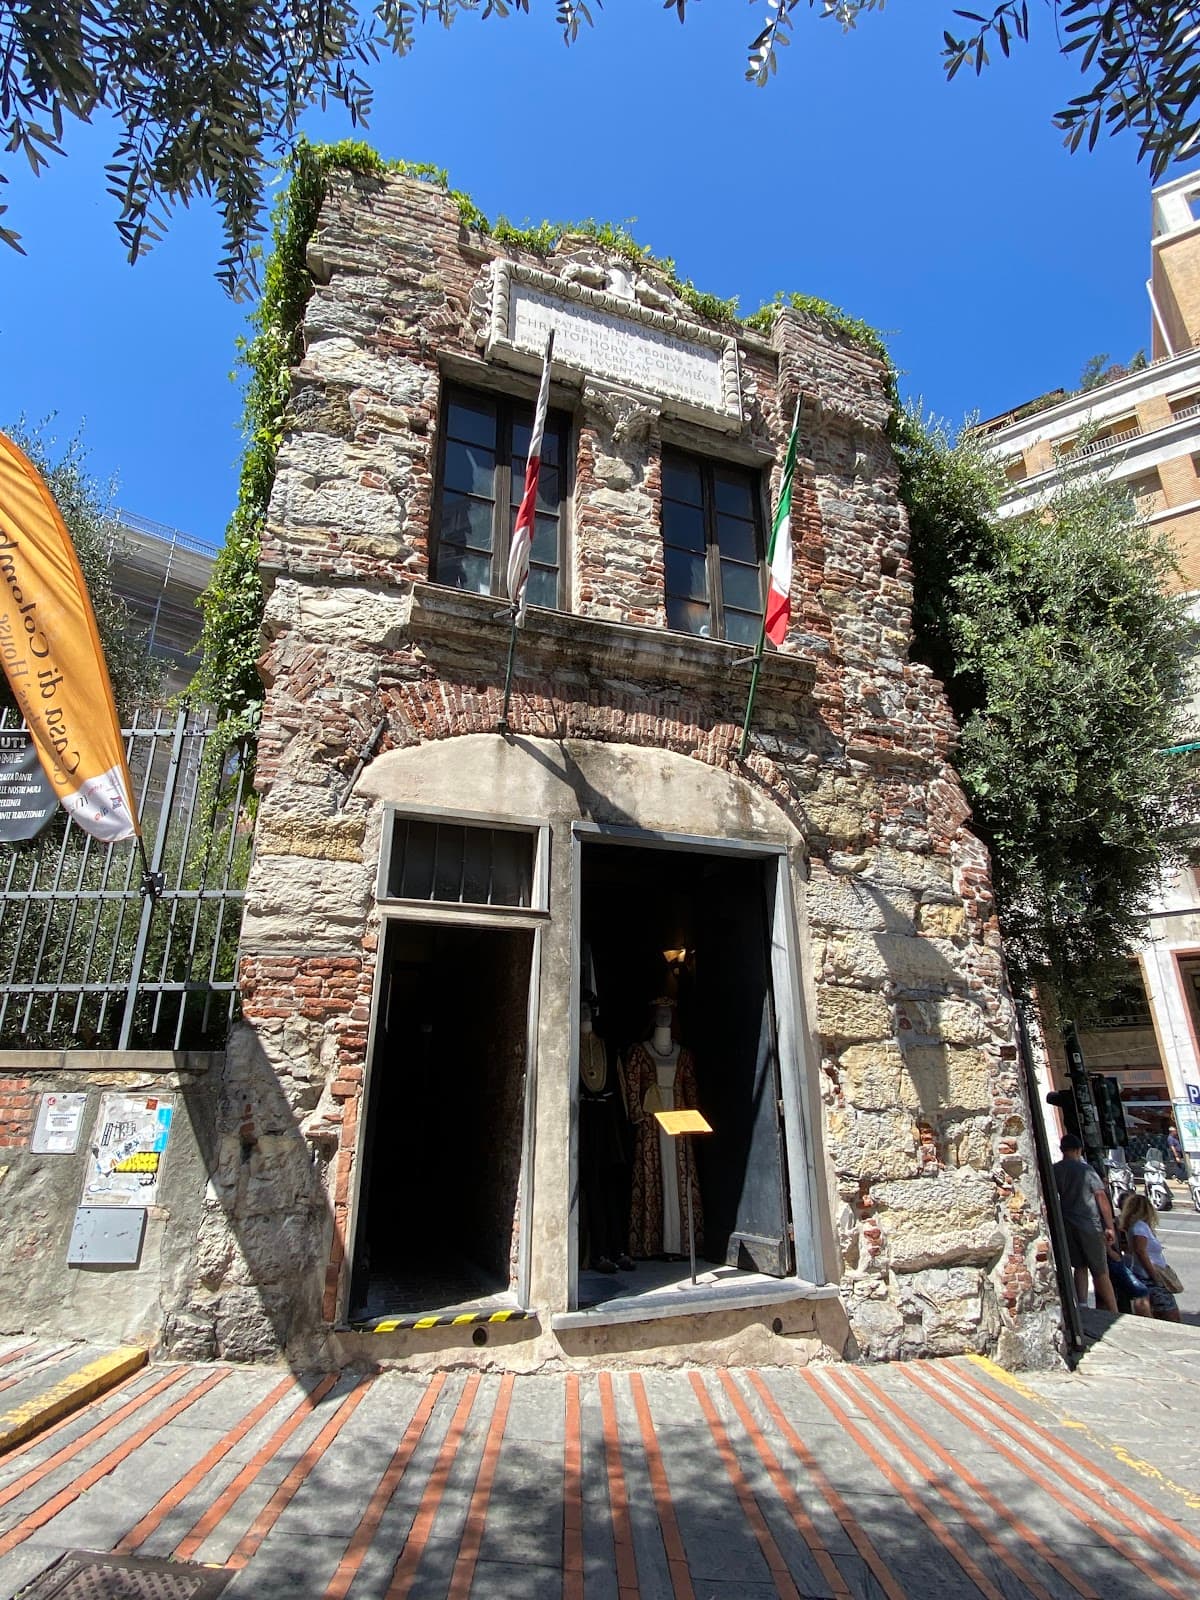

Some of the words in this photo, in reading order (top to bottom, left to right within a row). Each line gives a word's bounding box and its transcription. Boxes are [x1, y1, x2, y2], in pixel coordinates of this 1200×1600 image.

[554, 317, 608, 341] PATERNIS
[616, 337, 628, 347] IN
[635, 343, 683, 365] AEDIBVS
[571, 306, 609, 325] DOMVS
[664, 337, 706, 357] DIGNIOR
[520, 333, 586, 362] PRIMMQVE
[593, 356, 649, 382] IVVENTAM
[644, 354, 716, 386] COLVMBVS
[15, 771, 33, 782] DANTE
[1188, 1085, 1199, 1103] P
